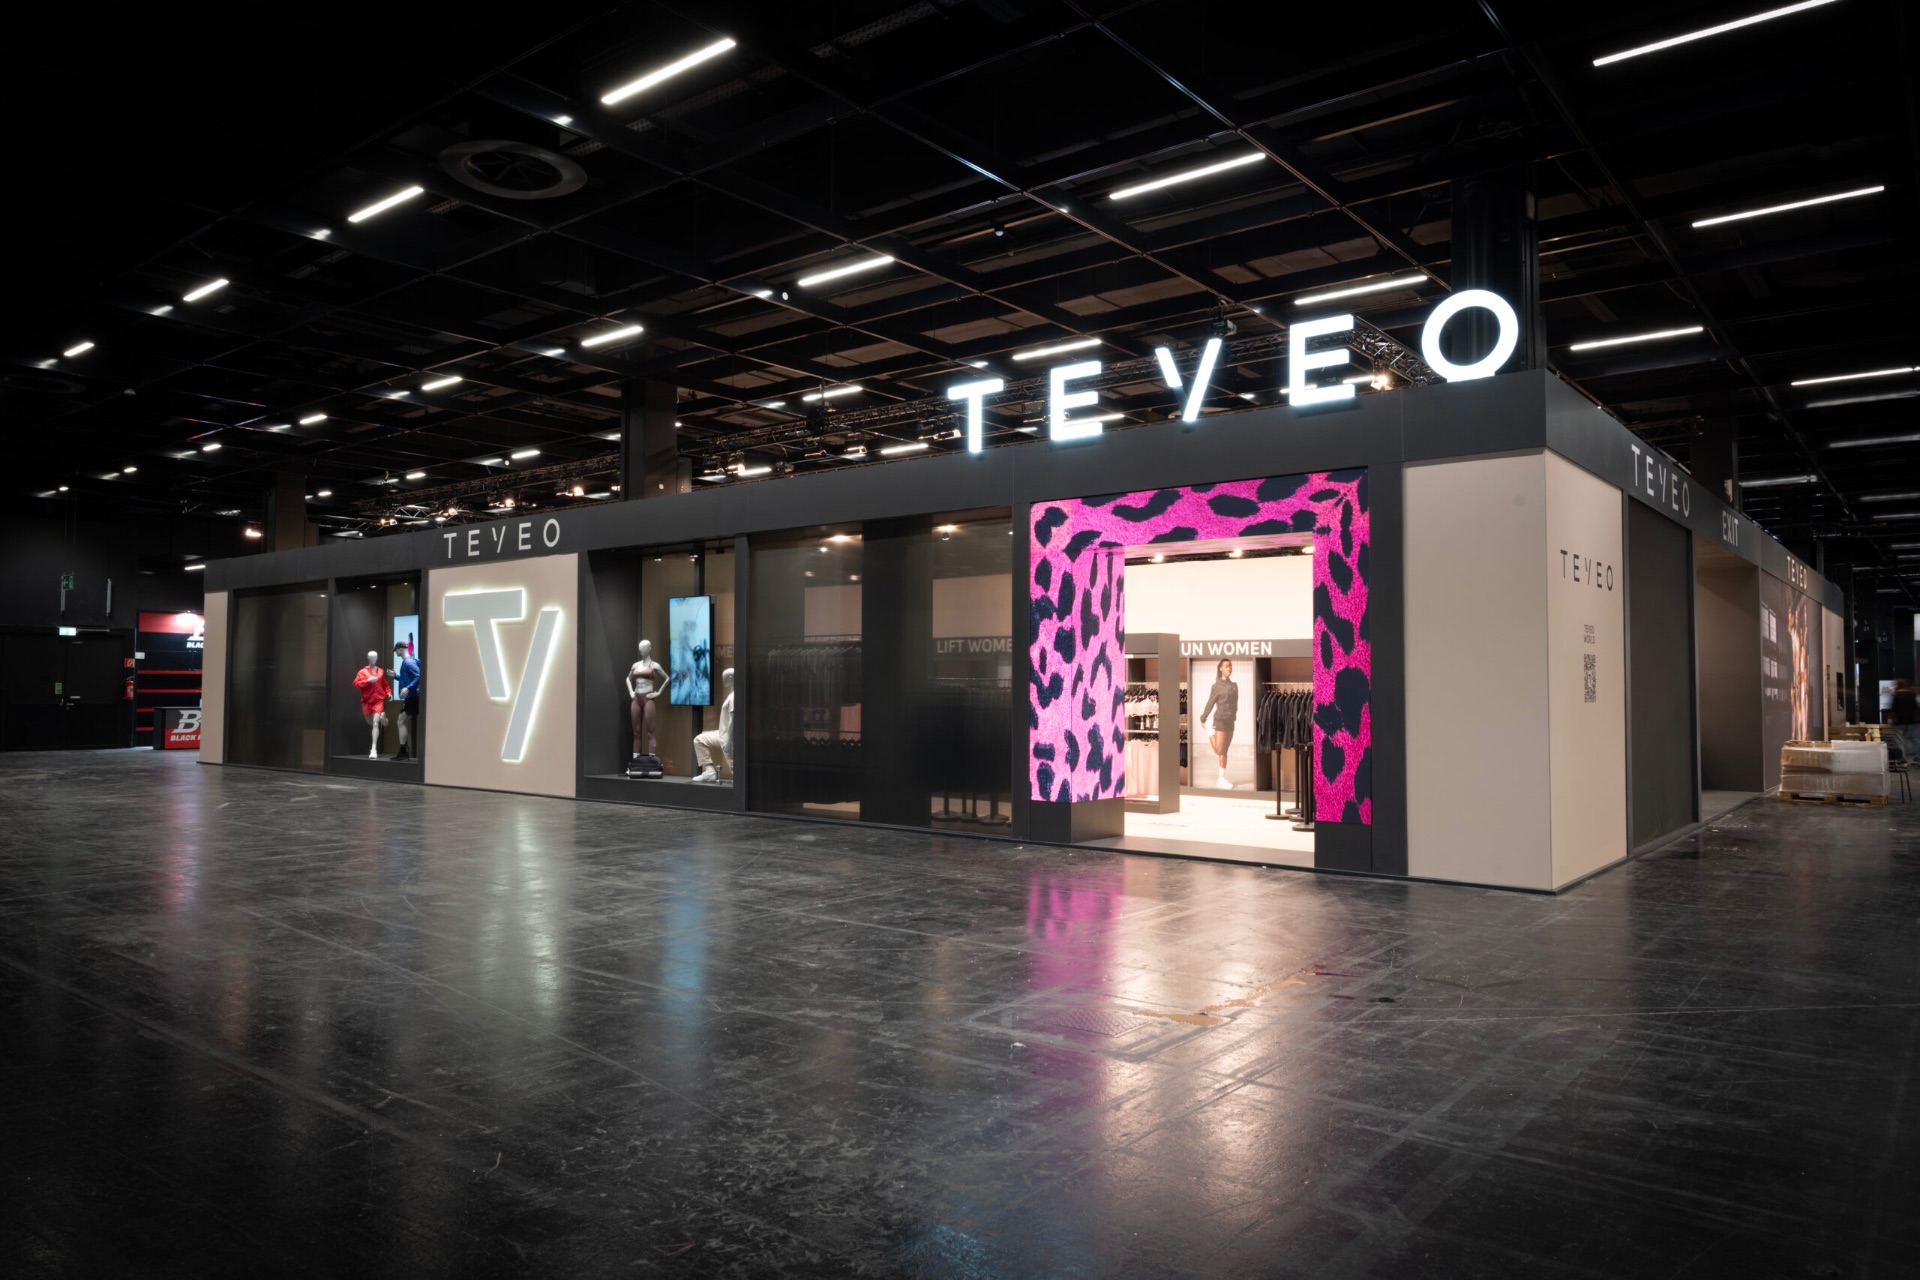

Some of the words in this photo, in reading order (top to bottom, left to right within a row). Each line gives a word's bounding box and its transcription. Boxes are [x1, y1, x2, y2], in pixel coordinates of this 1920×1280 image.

[947, 289, 1519, 453] TEVEO
[1631, 444, 1690, 518] TEVEO
[443, 518, 560, 558] TEVEO
[1722, 511, 1738, 547] EXIT
[1560, 549, 1613, 591] TEVEO
[1787, 555, 1808, 590] TEVEO
[937, 639, 965, 653] LIFT
[1207, 641, 1272, 655] WOMEN
[170, 734, 197, 742] BLACK
